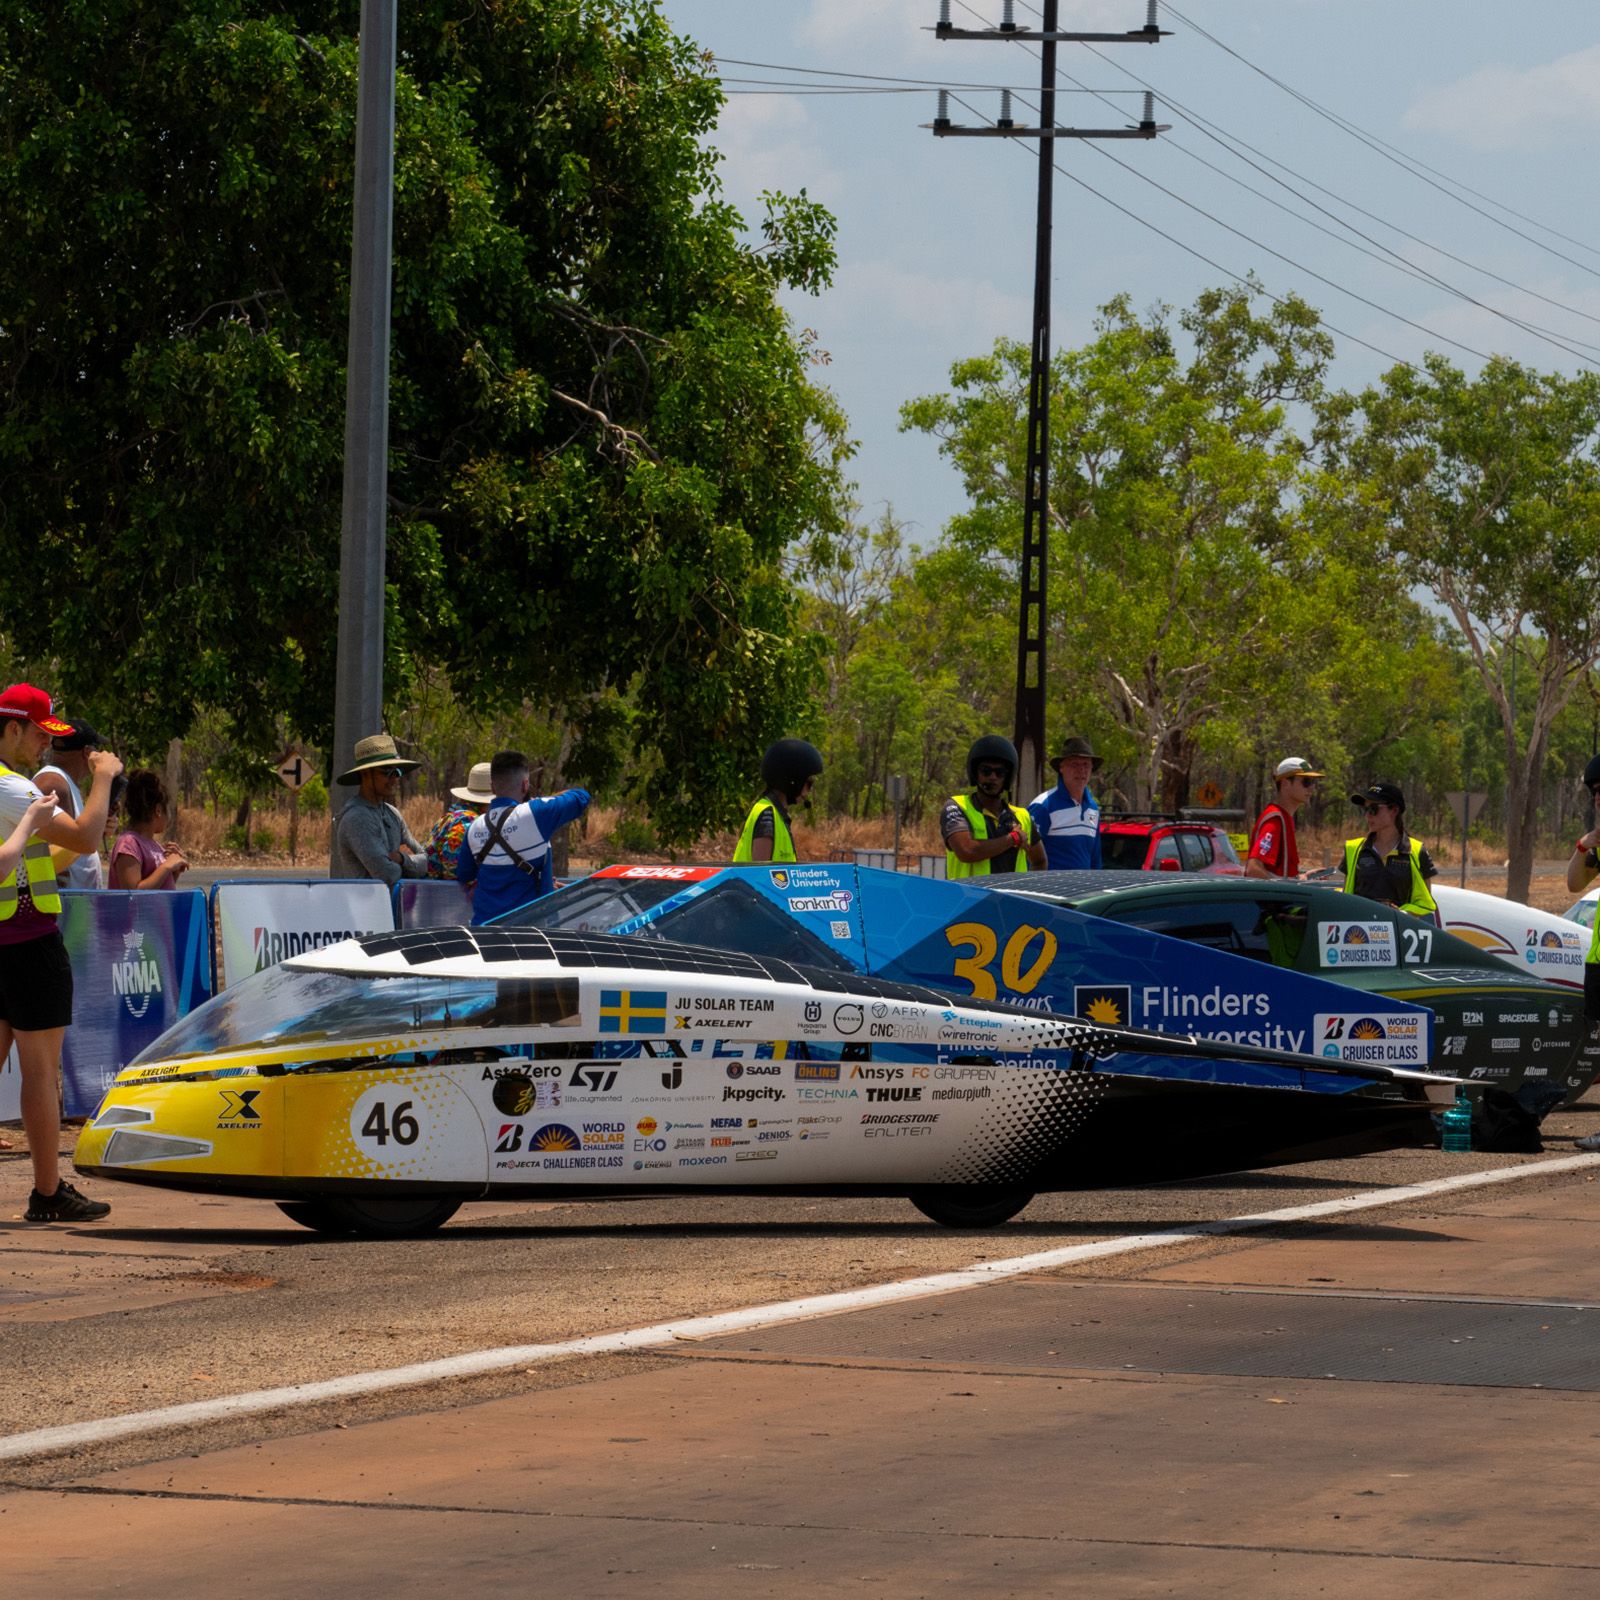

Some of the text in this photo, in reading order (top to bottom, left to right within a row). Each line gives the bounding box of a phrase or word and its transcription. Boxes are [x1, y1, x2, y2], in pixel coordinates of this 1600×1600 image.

[790, 869, 829, 878] Flinders
[792, 877, 841, 888] University
[790, 897, 838, 911] tonkin
[1402, 928, 1433, 964] 27
[944, 922, 1058, 1001] 30
[1340, 949, 1391, 962] CRUISER CLASS
[1537, 951, 1582, 966] CRUISER CLASS
[112, 960, 162, 995] NRMA
[674, 997, 774, 1012] JU SOLAR TEAM
[1001, 995, 1053, 1012] ears
[1143, 986, 1270, 1017] Flinders
[891, 1007, 928, 1017] AFRY
[694, 1019, 753, 1028] AXELENT
[959, 1017, 1003, 1029] Etteplan
[1387, 1018, 1418, 1026] WORLD
[942, 1030, 997, 1043] wiretronic
[1387, 1026, 1418, 1034] SOLAR
[1342, 1045, 1418, 1060] CRUISER CLASS
[937, 1054, 1057, 1070] Eeering
[140, 1066, 180, 1077] AXELIGHT
[746, 1066, 782, 1075] SAAB
[799, 1065, 838, 1078] ÖHLINS
[850, 1064, 904, 1082] Ansys
[911, 1067, 996, 1081] FC GRUPPEN
[722, 1086, 786, 1102] jkpgcity.
[797, 1088, 859, 1099] TECHNIA
[866, 1087, 922, 1102] THULE
[932, 1086, 991, 1102] mediaspjuth
[361, 1101, 419, 1146] 46
[710, 1118, 743, 1128] NEFAB
[860, 1114, 941, 1125] BRIDGESTONE
[582, 1123, 625, 1133] WORLD
[582, 1133, 625, 1143] SOLAR
[633, 1138, 667, 1152] EKO
[736, 1150, 778, 1159] CREO
[543, 1158, 596, 1170] CHALLENGER
[597, 1156, 624, 1168] CLASS
[679, 1156, 728, 1167] maxeon
